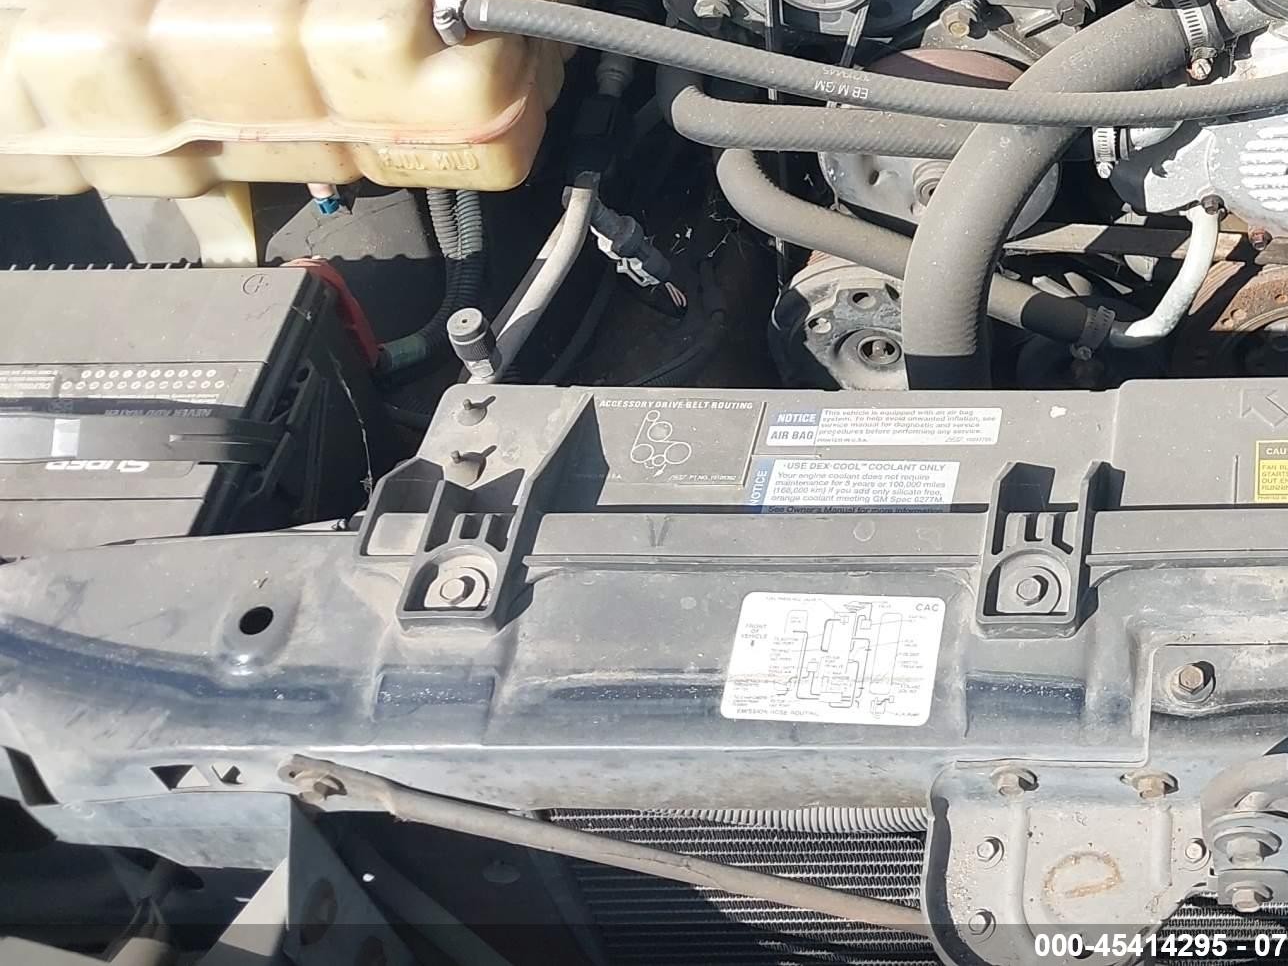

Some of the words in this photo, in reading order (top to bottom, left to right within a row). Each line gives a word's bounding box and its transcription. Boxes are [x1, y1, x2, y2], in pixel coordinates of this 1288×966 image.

[837, 83, 850, 96] M
[851, 86, 870, 100] EB
[599, 400, 655, 409] ACCESSORY
[655, 401, 685, 409] DRIVE
[685, 401, 709, 409] BELT
[711, 402, 753, 410] ROUTING
[777, 413, 817, 423] NOTICE
[770, 430, 789, 440] AIR
[791, 431, 814, 440] BAG
[868, 463, 917, 471] COOLANT
[919, 464, 946, 472] ONLY
[798, 472, 826, 480] engine
[828, 472, 860, 480] coolant
[889, 481, 922, 489] 100,000
[835, 488, 851, 496] you
[872, 488, 890, 497] only
[770, 495, 801, 503] orange
[836, 495, 871, 504] meeting
[823, 506, 856, 514] Manual
[915, 602, 940, 612] CAC
